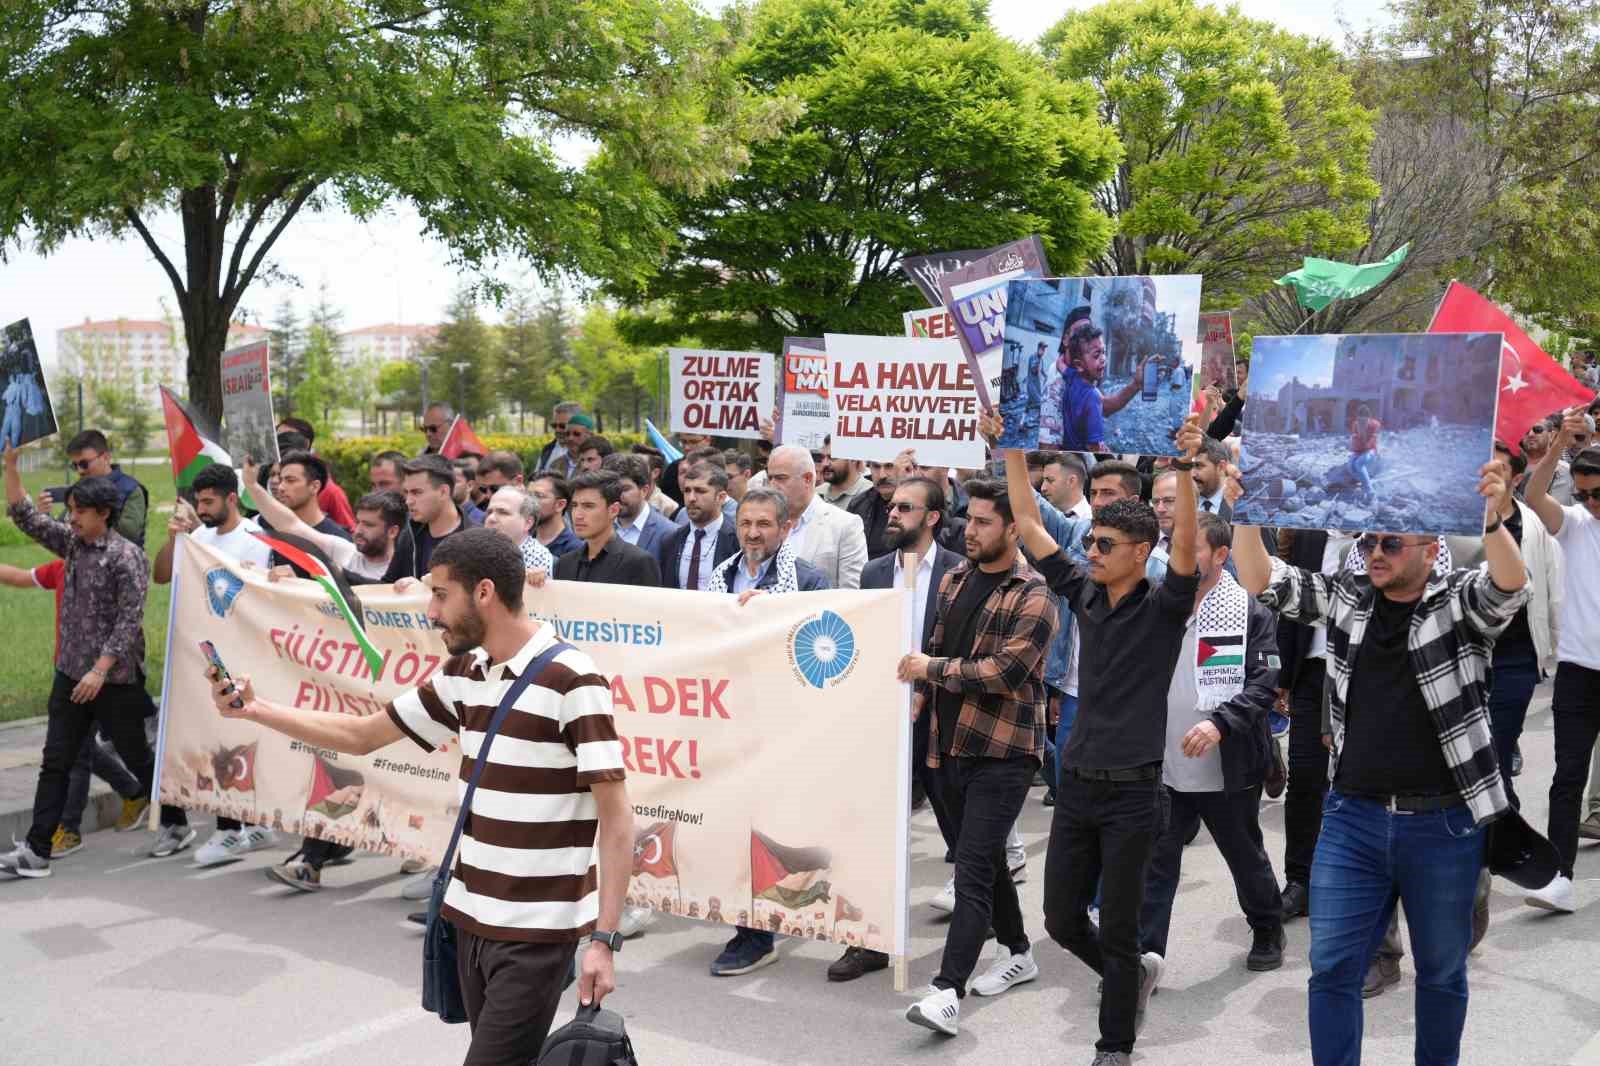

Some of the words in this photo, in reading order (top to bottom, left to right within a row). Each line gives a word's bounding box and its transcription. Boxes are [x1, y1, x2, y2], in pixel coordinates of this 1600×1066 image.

[958, 287, 1008, 325] UN
[979, 312, 1005, 346] M
[682, 356, 761, 378] ZULME
[788, 355, 831, 374] UNU
[834, 362, 869, 389] LA
[877, 362, 976, 391] HAVLE
[683, 380, 761, 402] ORTAK
[836, 394, 881, 412] VELA
[886, 396, 976, 414] KUVVETE
[683, 403, 760, 431] OLMA
[528, 612, 664, 646] İVERSİTESİ
[394, 643, 440, 687] ÖZ
[643, 675, 731, 720] DEK
[372, 757, 451, 782] #FreePalestine
[618, 735, 702, 779] REK!
[631, 805, 703, 825] asefireNow!
